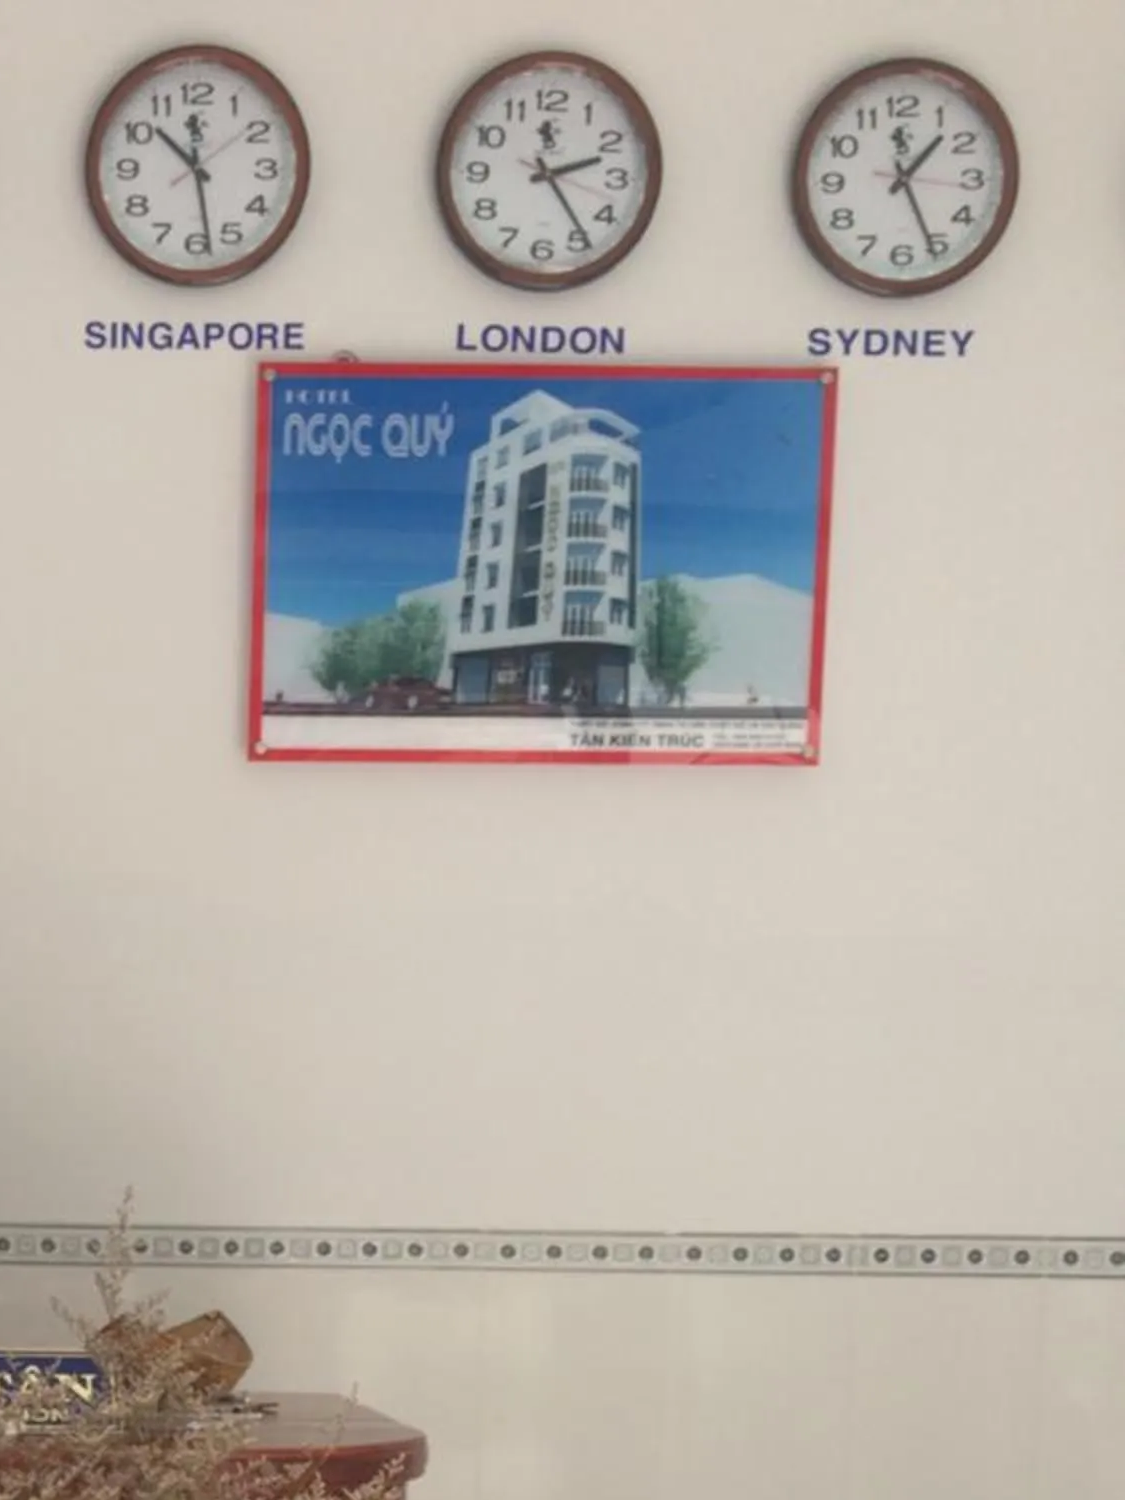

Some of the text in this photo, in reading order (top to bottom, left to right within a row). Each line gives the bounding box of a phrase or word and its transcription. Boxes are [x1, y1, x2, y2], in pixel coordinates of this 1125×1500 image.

[181, 83, 214, 105] 12
[536, 90, 569, 112] 12
[151, 95, 171, 117] 11
[230, 95, 238, 117] 1
[505, 99, 525, 122] 11
[583, 103, 593, 125] 1
[886, 95, 920, 118] 12
[936, 106, 943, 128] 1
[857, 107, 877, 130] 11
[125, 121, 153, 144] 10
[246, 121, 270, 144] 2
[477, 126, 506, 149] 10
[599, 130, 623, 153] 2
[951, 132, 976, 154] 2
[830, 134, 859, 158] 10
[116, 158, 139, 180] 9
[254, 158, 278, 180] 3
[466, 161, 490, 184] 9
[604, 168, 628, 190] 3
[960, 168, 985, 190] 3
[821, 172, 845, 194] 9
[125, 195, 149, 217] 8
[244, 195, 268, 216] 4
[474, 198, 498, 220] 8
[594, 204, 617, 225] 4
[951, 205, 976, 225] 4
[830, 208, 855, 230] 8
[152, 223, 172, 244] 7
[184, 233, 209, 255] 6
[219, 223, 243, 245] 5
[498, 227, 519, 249] 7
[567, 230, 590, 252] 5
[929, 233, 949, 256] 5
[530, 240, 554, 261] 6
[857, 235, 878, 256] 7
[889, 245, 915, 266] 6
[84, 321, 305, 350] SINGAPORE
[455, 323, 626, 354] LONDON
[807, 328, 974, 357] SYDNEY
